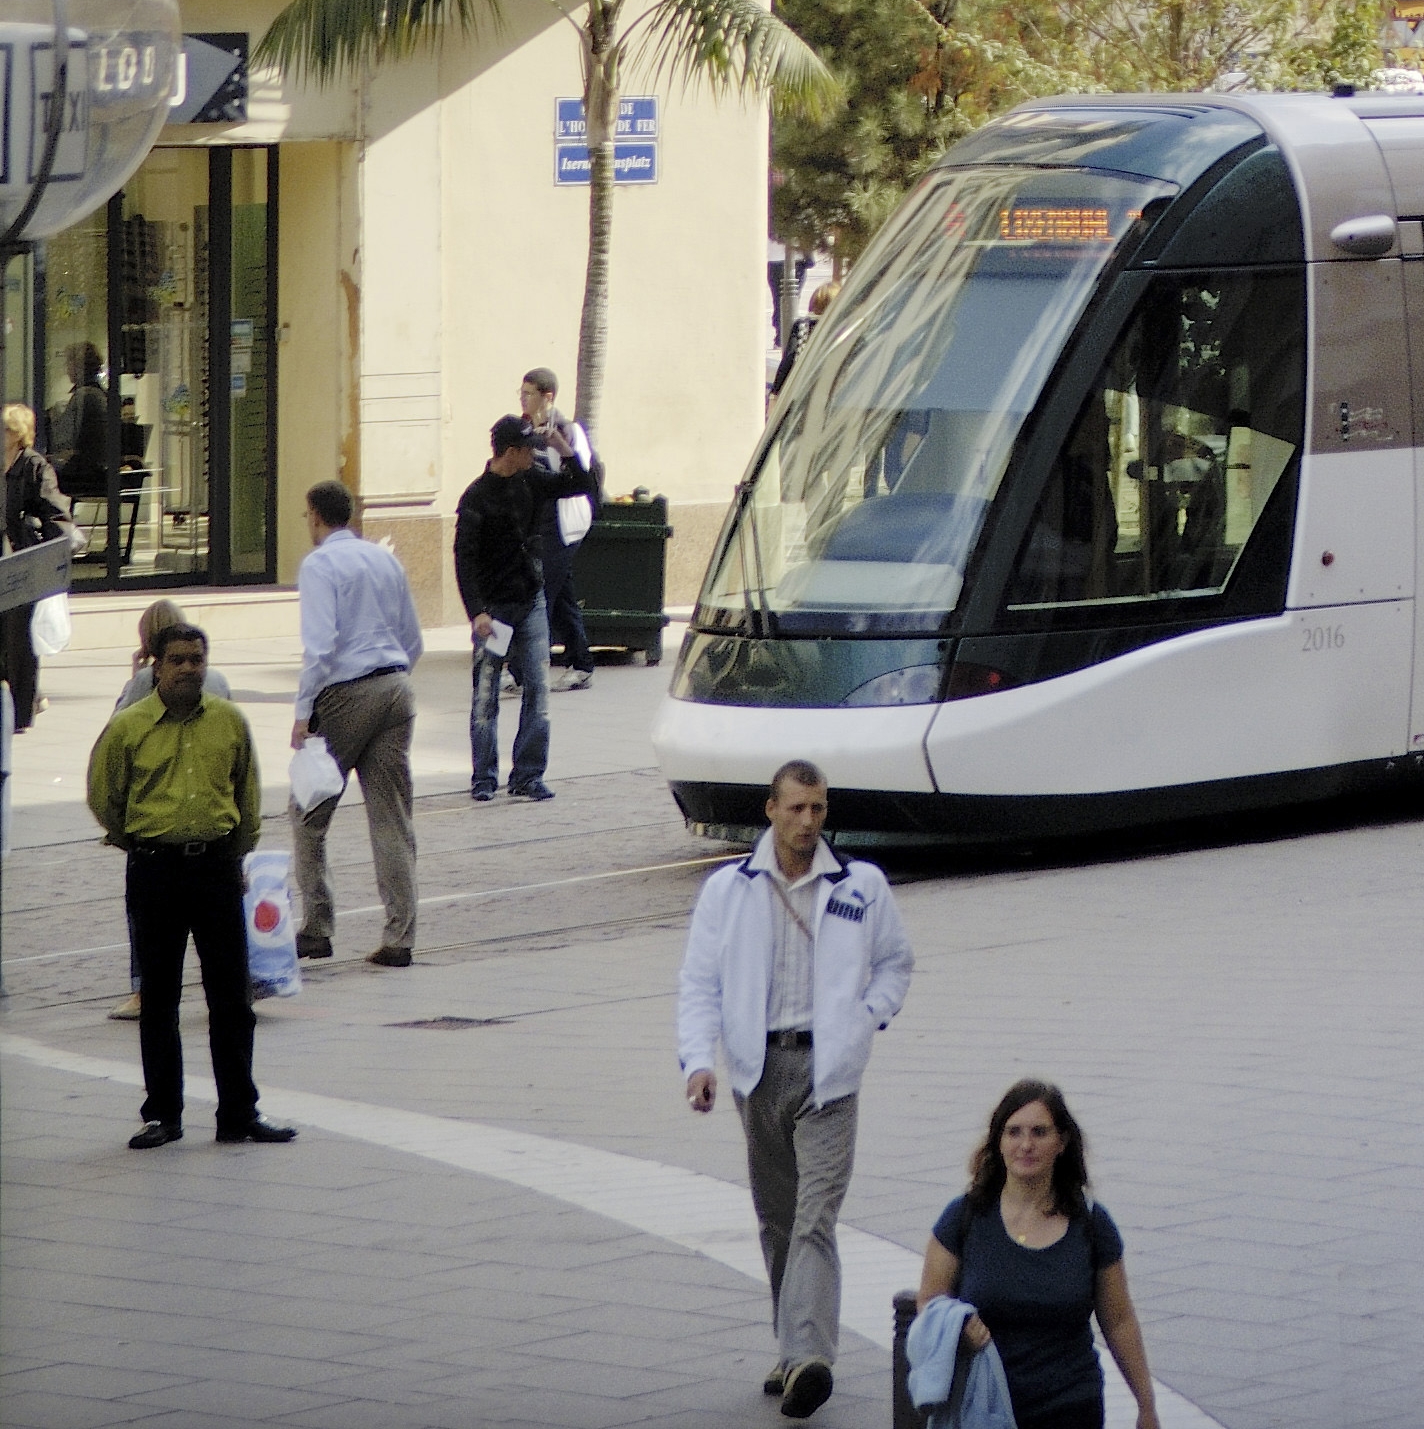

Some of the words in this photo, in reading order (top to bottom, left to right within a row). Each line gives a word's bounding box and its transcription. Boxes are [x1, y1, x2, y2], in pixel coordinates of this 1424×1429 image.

[40, 91, 88, 133] TXI
[620, 102, 634, 115] DE
[616, 119, 632, 132] DE
[637, 119, 656, 132] FER
[1301, 623, 1345, 652] 2016
